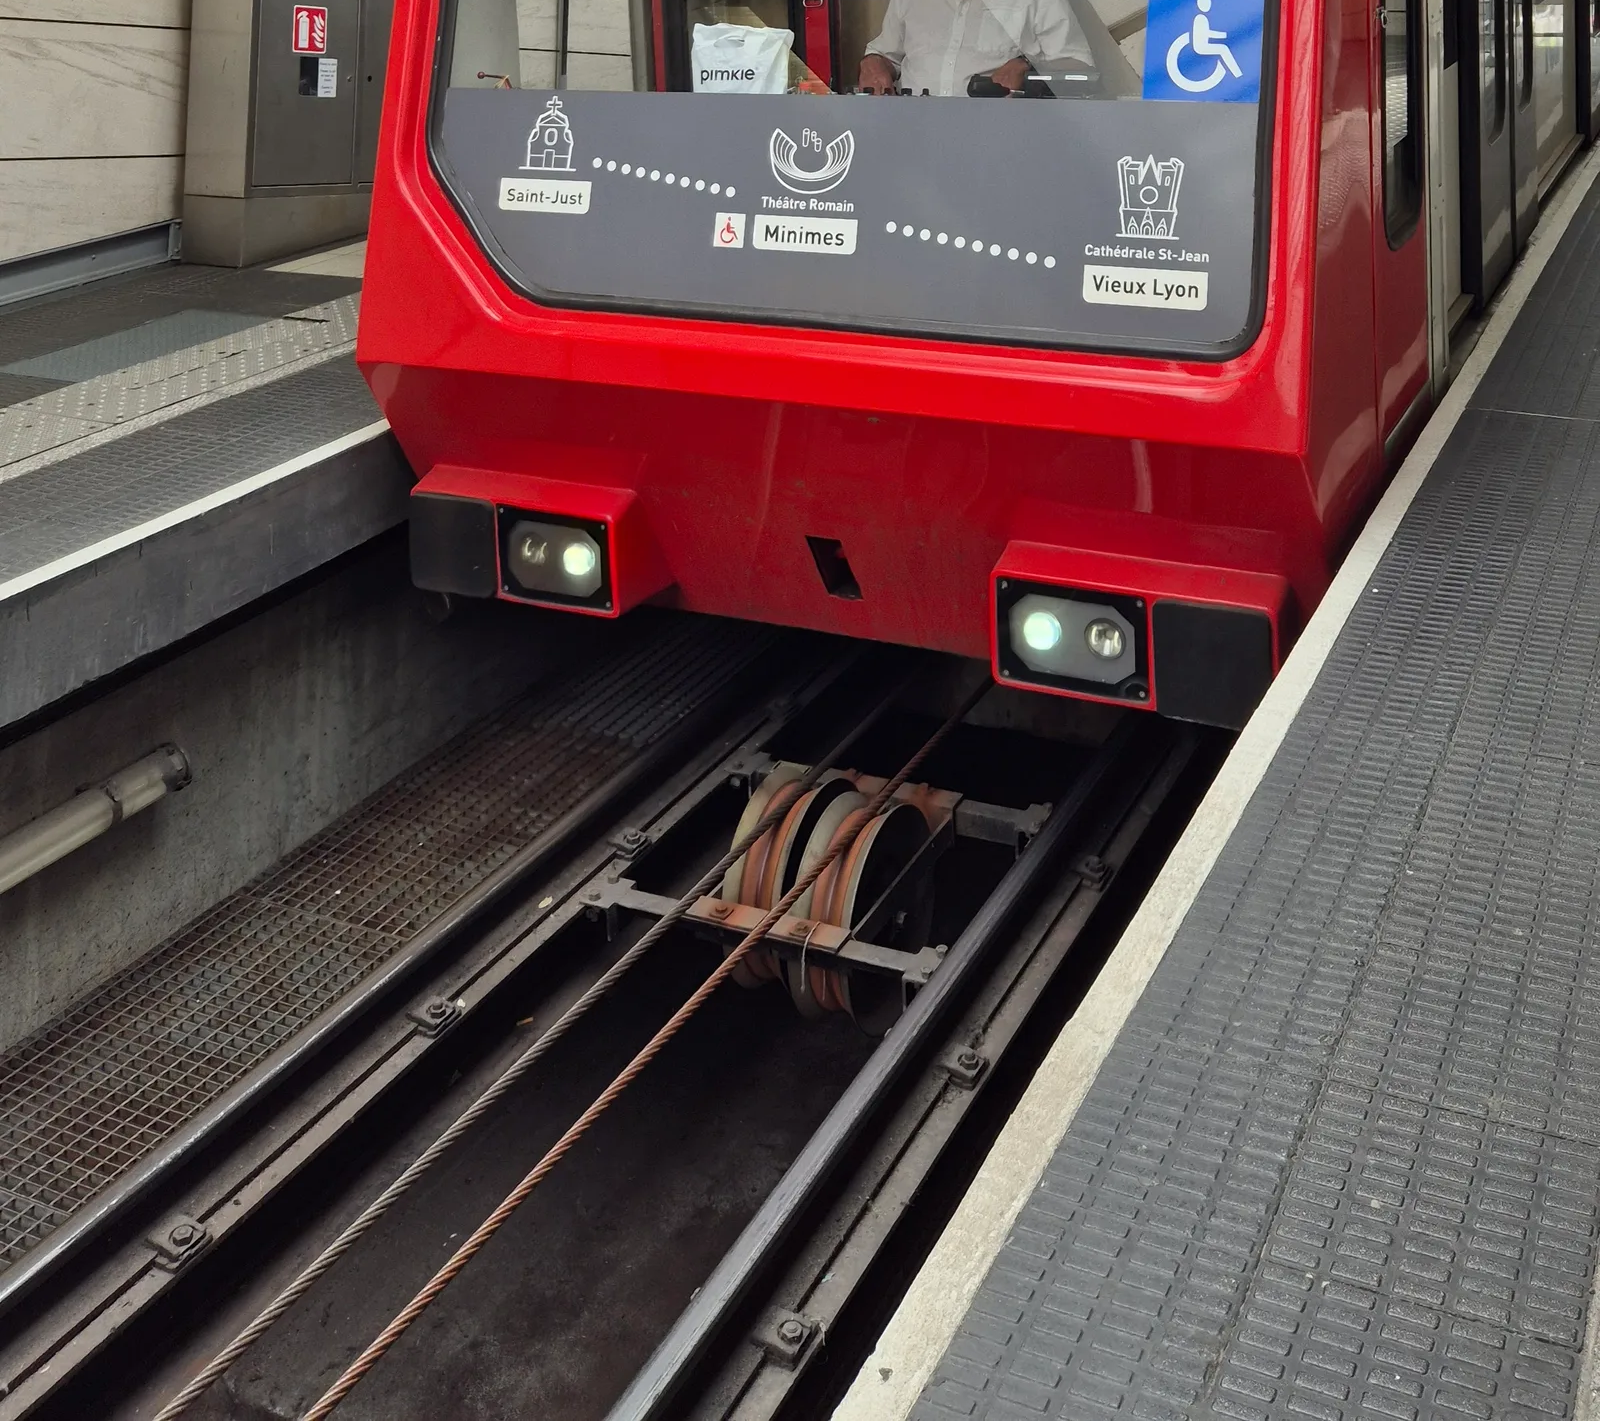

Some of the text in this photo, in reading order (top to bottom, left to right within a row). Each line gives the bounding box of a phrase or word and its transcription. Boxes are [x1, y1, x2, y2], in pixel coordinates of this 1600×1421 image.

[700, 68, 755, 84] pimkie
[507, 188, 584, 205] Saint-Just
[761, 196, 854, 212] Théâtre Romain
[764, 224, 845, 246] Minimes
[1084, 243, 1210, 263] Cathédrale St-Jean
[1092, 274, 1199, 300] Vieux Lyon
